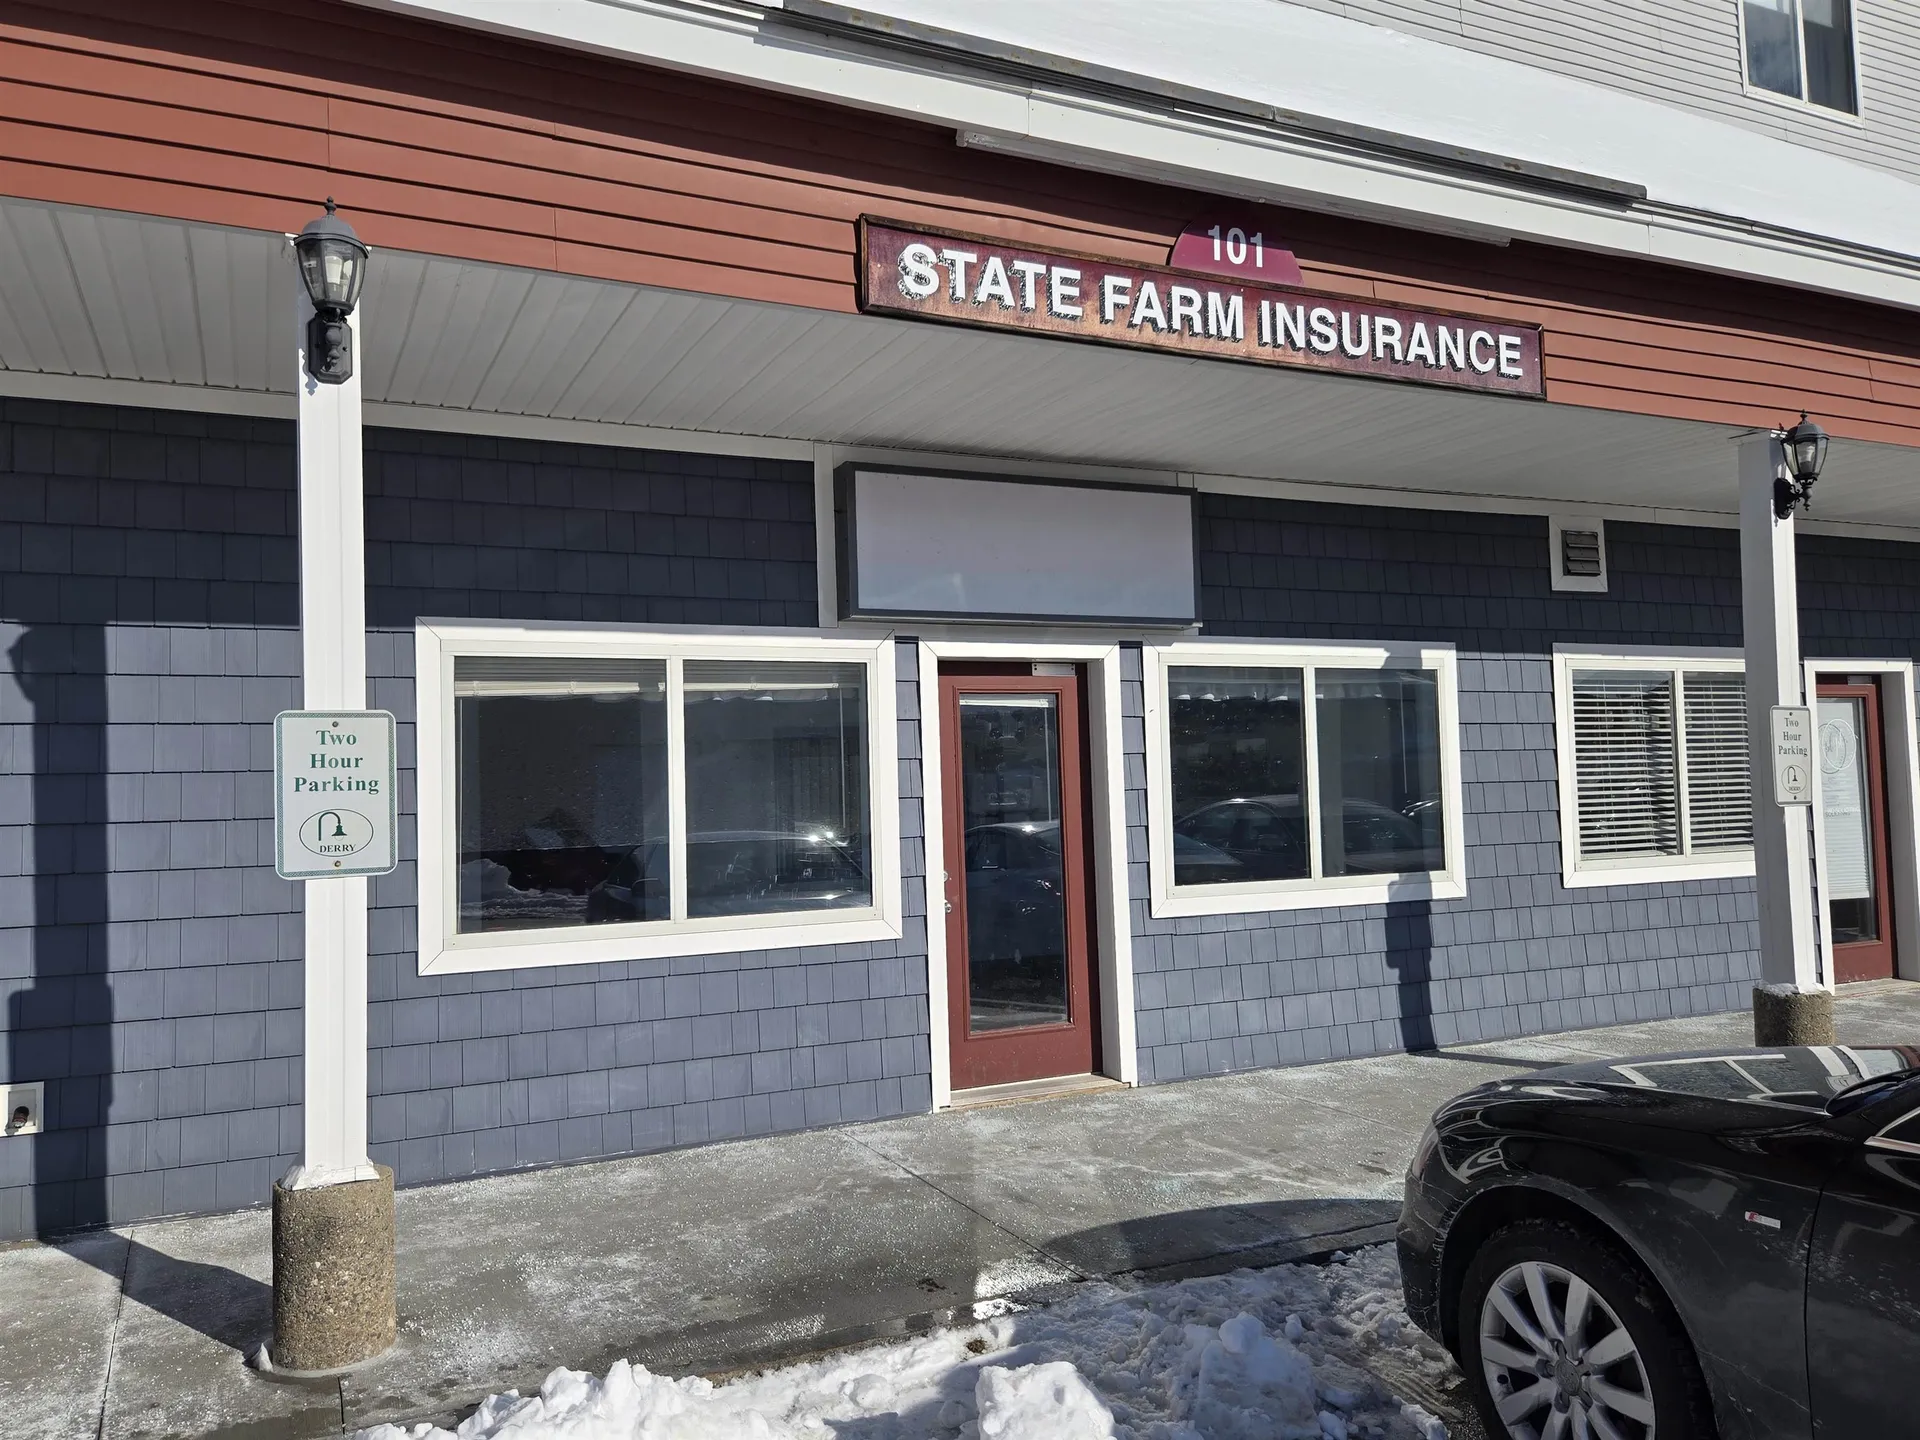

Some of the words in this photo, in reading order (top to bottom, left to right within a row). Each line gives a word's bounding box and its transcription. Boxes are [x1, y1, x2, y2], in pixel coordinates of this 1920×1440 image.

[1207, 224, 1264, 268] 101
[899, 243, 1083, 321] STATE
[1099, 274, 1245, 344] FARM
[1258, 300, 1524, 380] INSURANCE
[1784, 717, 1799, 727] Two
[316, 730, 357, 746] Two
[1782, 731, 1802, 741] Hour
[1778, 745, 1808, 757] Parking
[310, 753, 364, 769] Hour
[293, 776, 380, 795] Parking
[319, 844, 357, 853] DERRY
